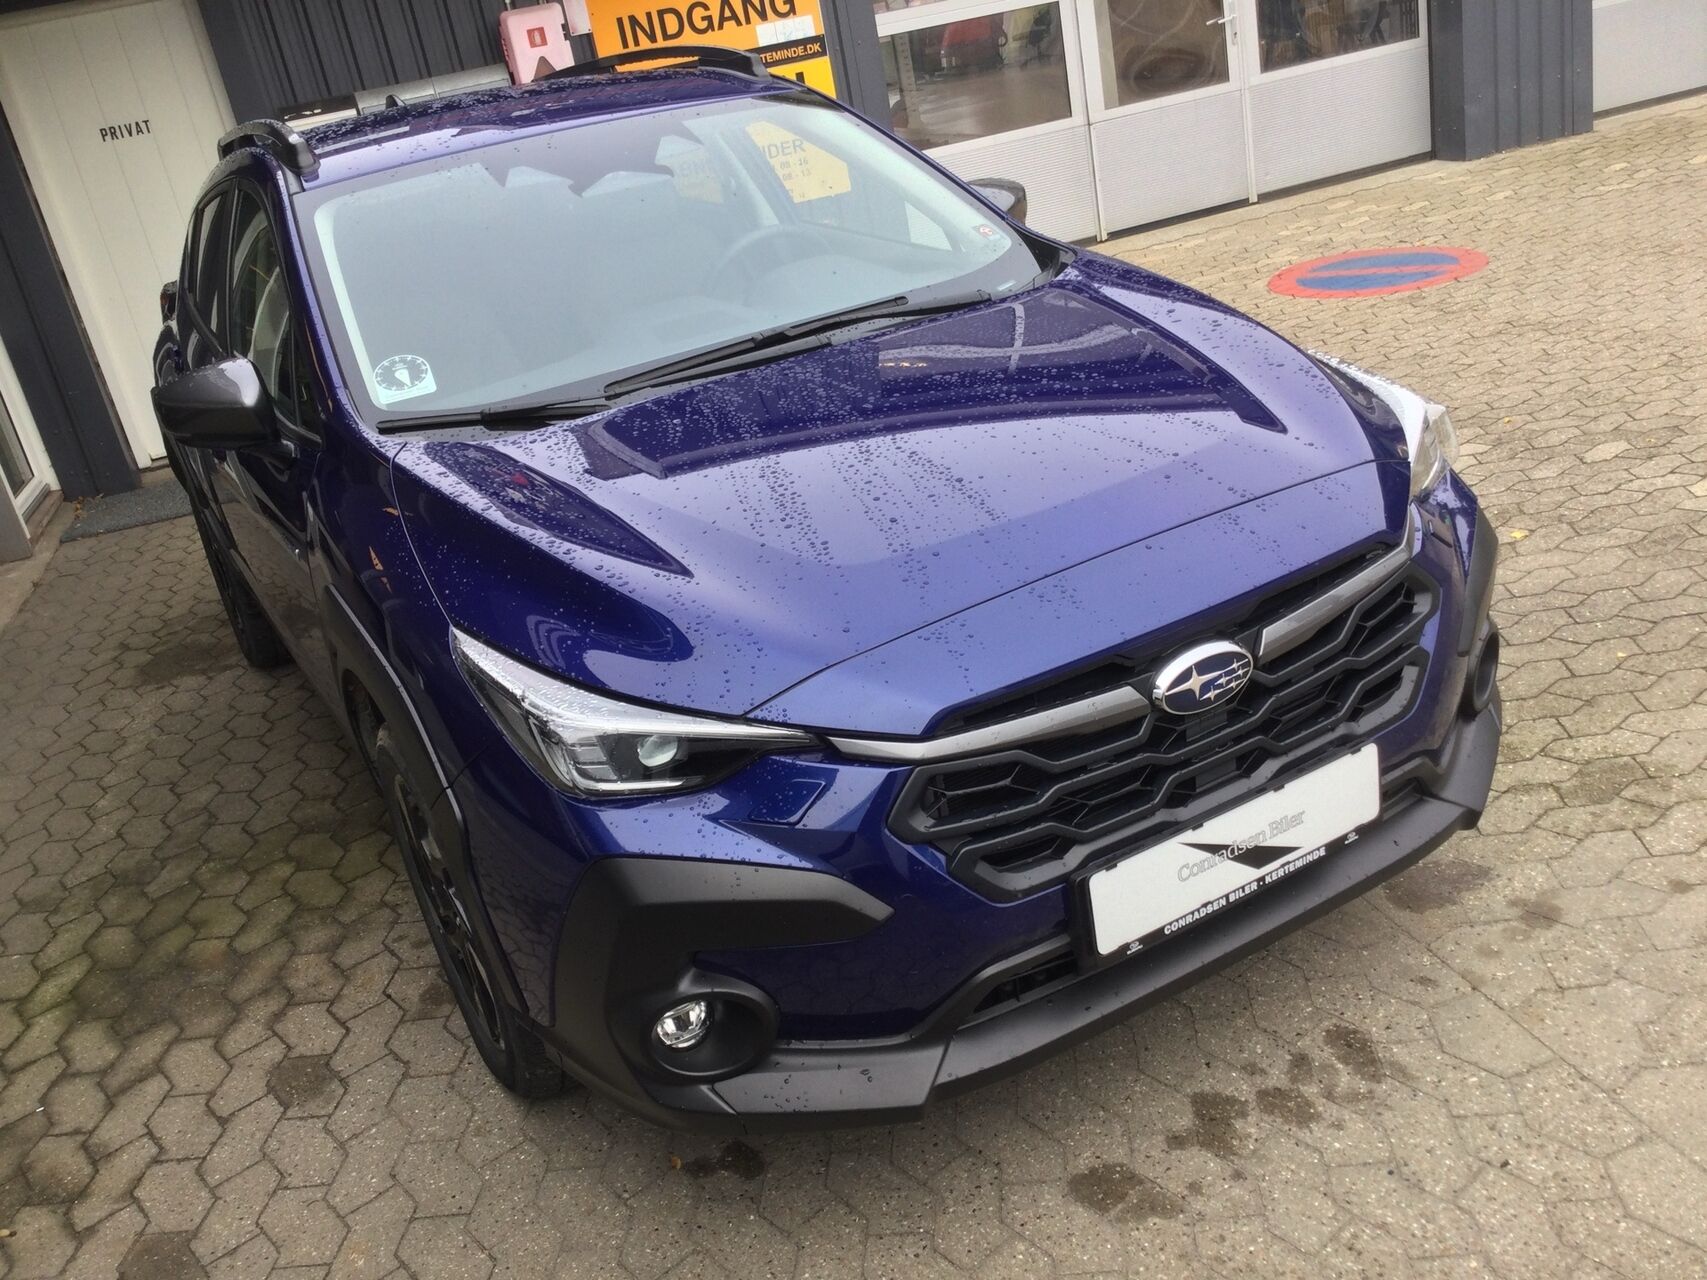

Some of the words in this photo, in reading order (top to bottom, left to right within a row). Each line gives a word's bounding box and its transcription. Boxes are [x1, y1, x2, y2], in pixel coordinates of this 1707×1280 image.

[616, 0, 797, 49] INDGANG
[99, 119, 151, 142] PRIVAT
[1177, 830, 1267, 882] Conradsen
[1268, 810, 1305, 839] Biler
[1164, 896, 1227, 935] CONRADSEN
[1228, 881, 1259, 903] BILER
[1265, 846, 1327, 884] KERTEMINDE
